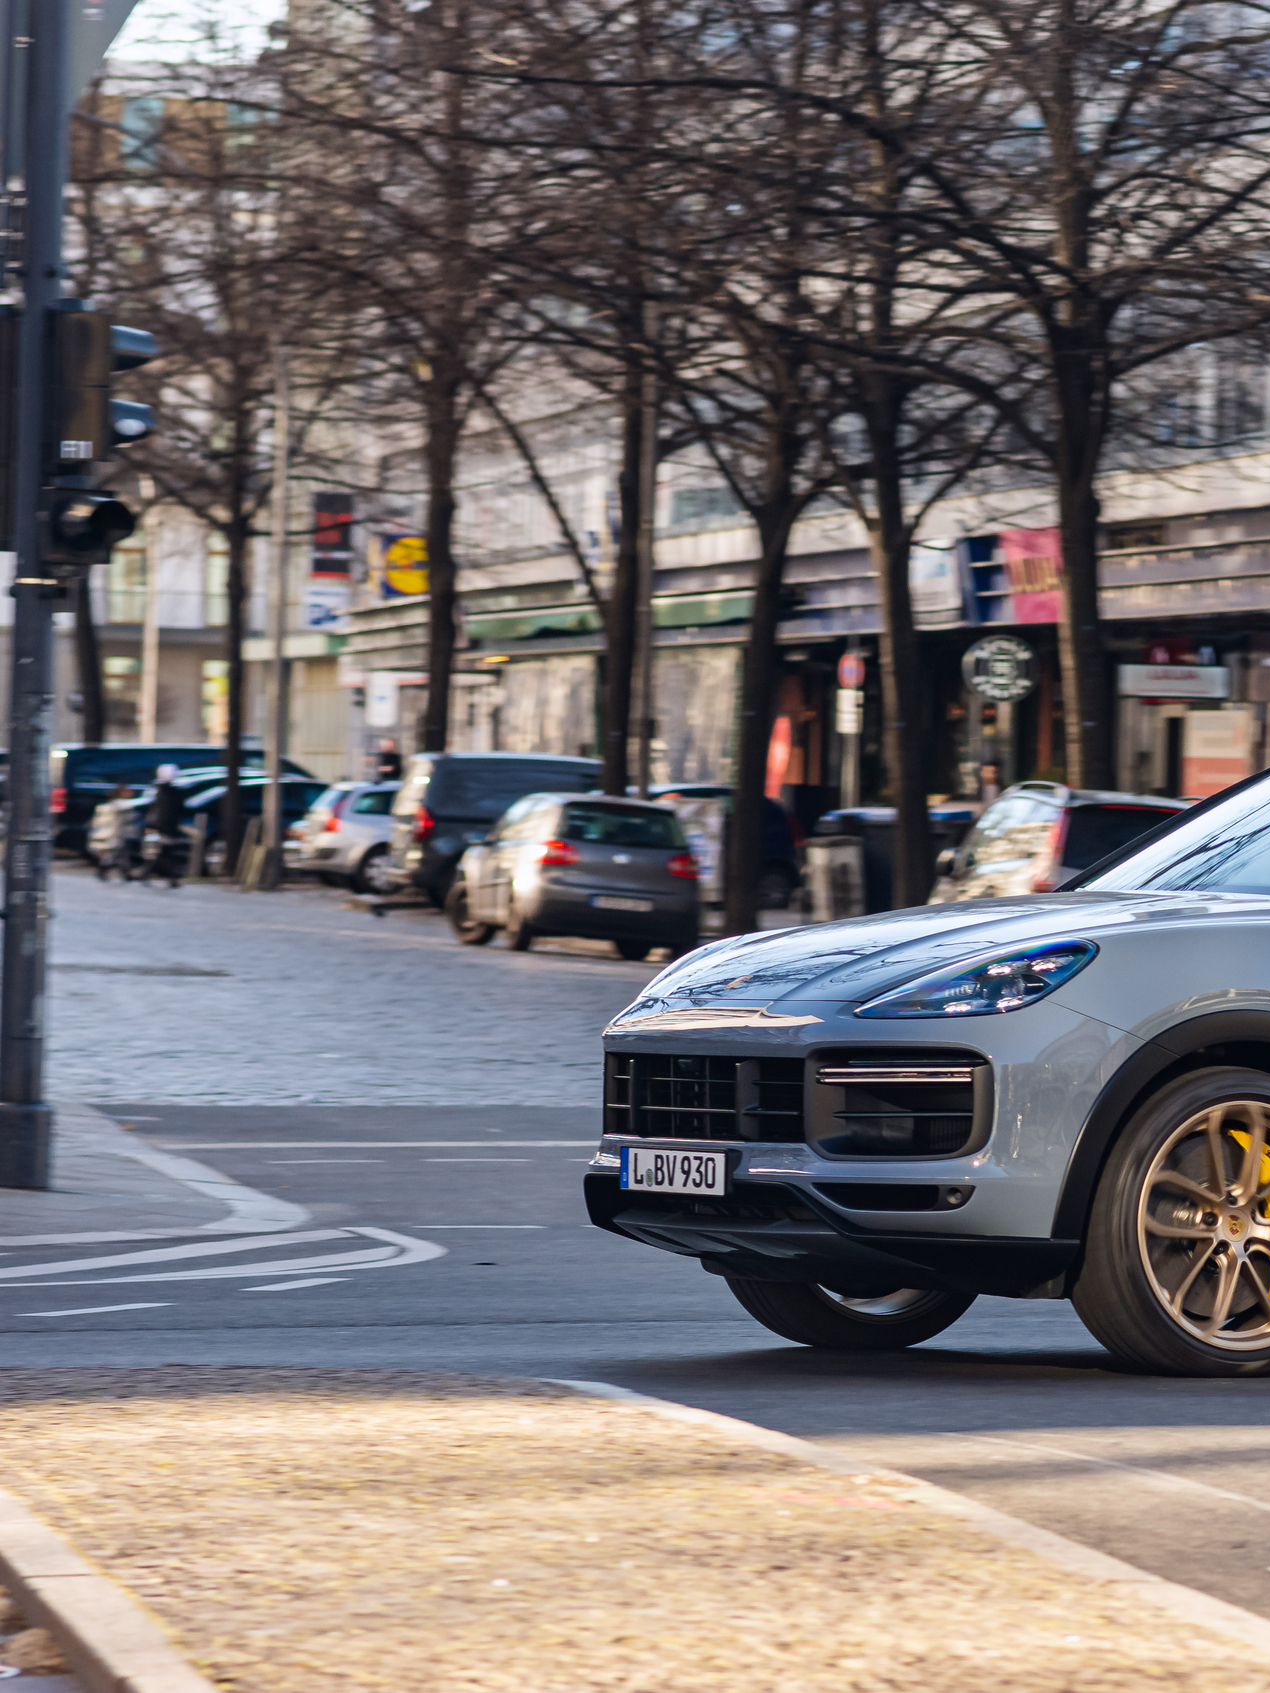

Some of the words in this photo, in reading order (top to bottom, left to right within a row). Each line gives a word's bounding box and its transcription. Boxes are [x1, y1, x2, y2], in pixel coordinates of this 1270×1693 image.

[634, 1152, 644, 1185] L
[655, 1154, 677, 1186] BV
[681, 1155, 716, 1189] 930
